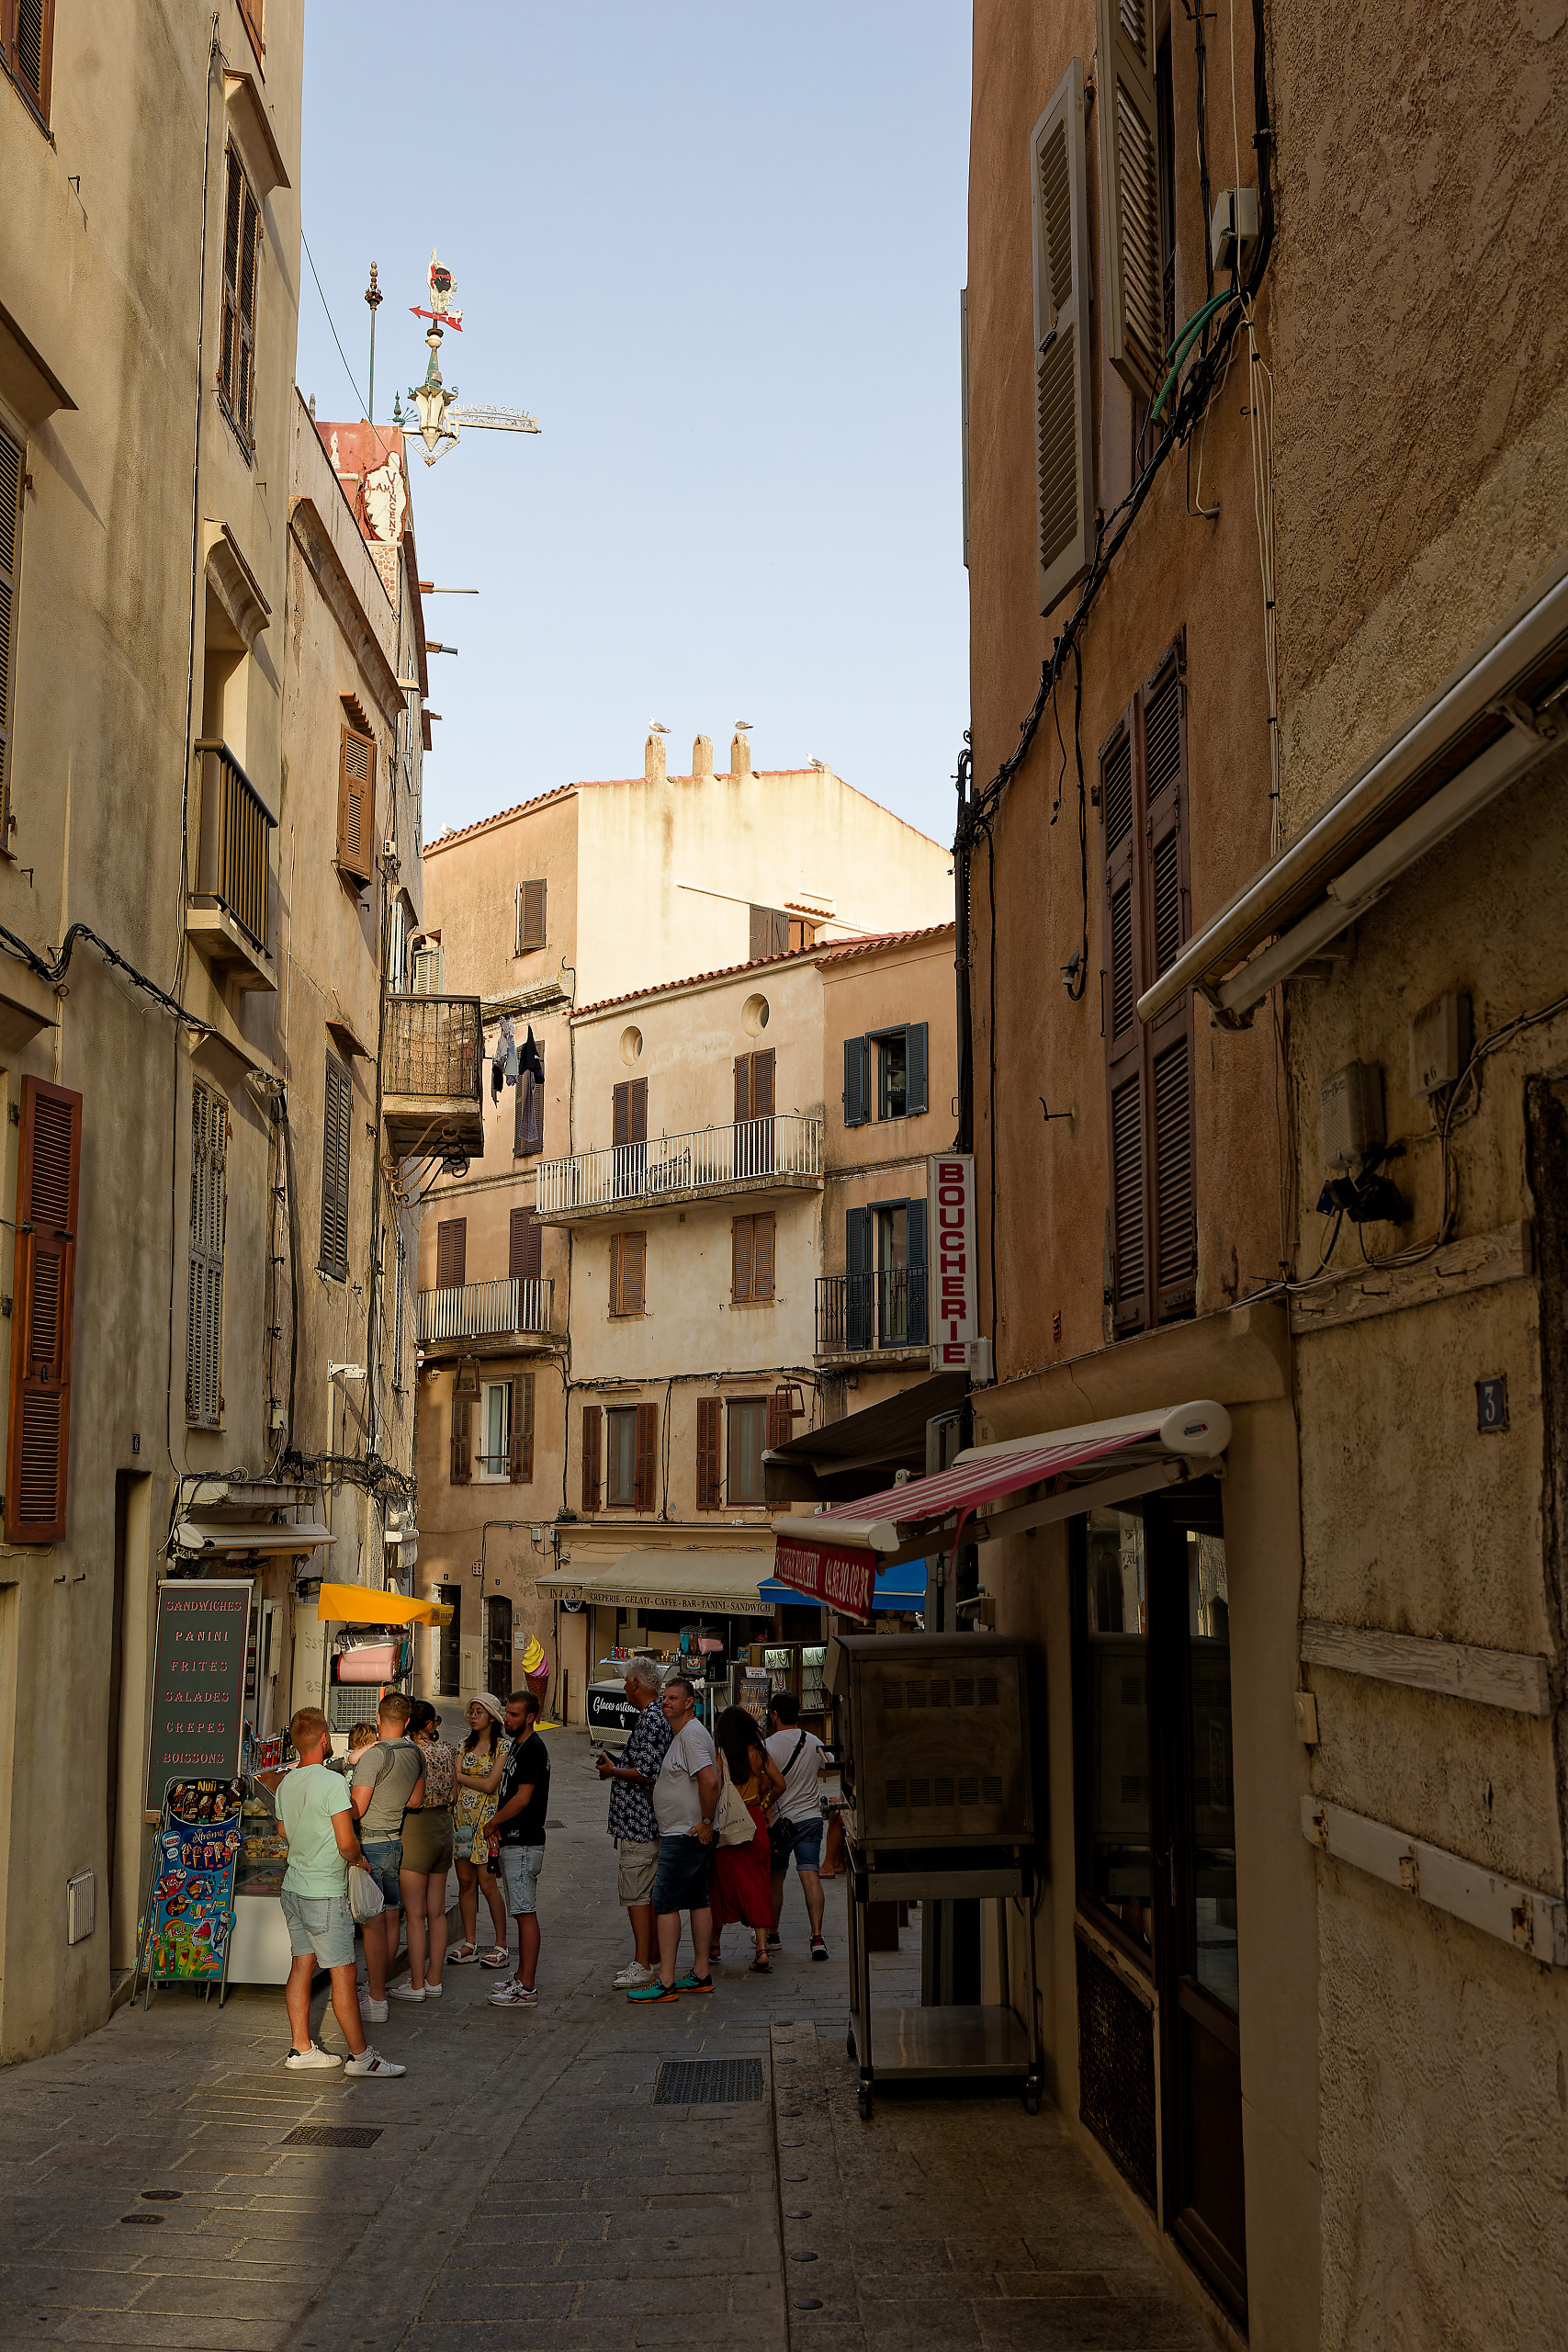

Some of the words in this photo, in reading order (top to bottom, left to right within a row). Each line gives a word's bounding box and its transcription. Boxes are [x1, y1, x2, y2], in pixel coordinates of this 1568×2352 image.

[938, 1163, 966, 1363] BOUCHERIE
[1484, 1385, 1495, 1422] 3
[165, 1600, 242, 1611] SANDWICHES
[625, 1595, 651, 1605] GELATI
[682, 1600, 697, 1608] BAR
[702, 1600, 726, 1610] PANINI
[730, 1601, 771, 1612] SANDWICH
[175, 1631, 229, 1642] PANINI
[171, 1661, 228, 1672] FRITES
[164, 1691, 230, 1702] SALADES
[592, 1696, 615, 1713] Glaces
[165, 1722, 225, 1733] CREPES
[163, 1752, 224, 1764] BOISSONS
